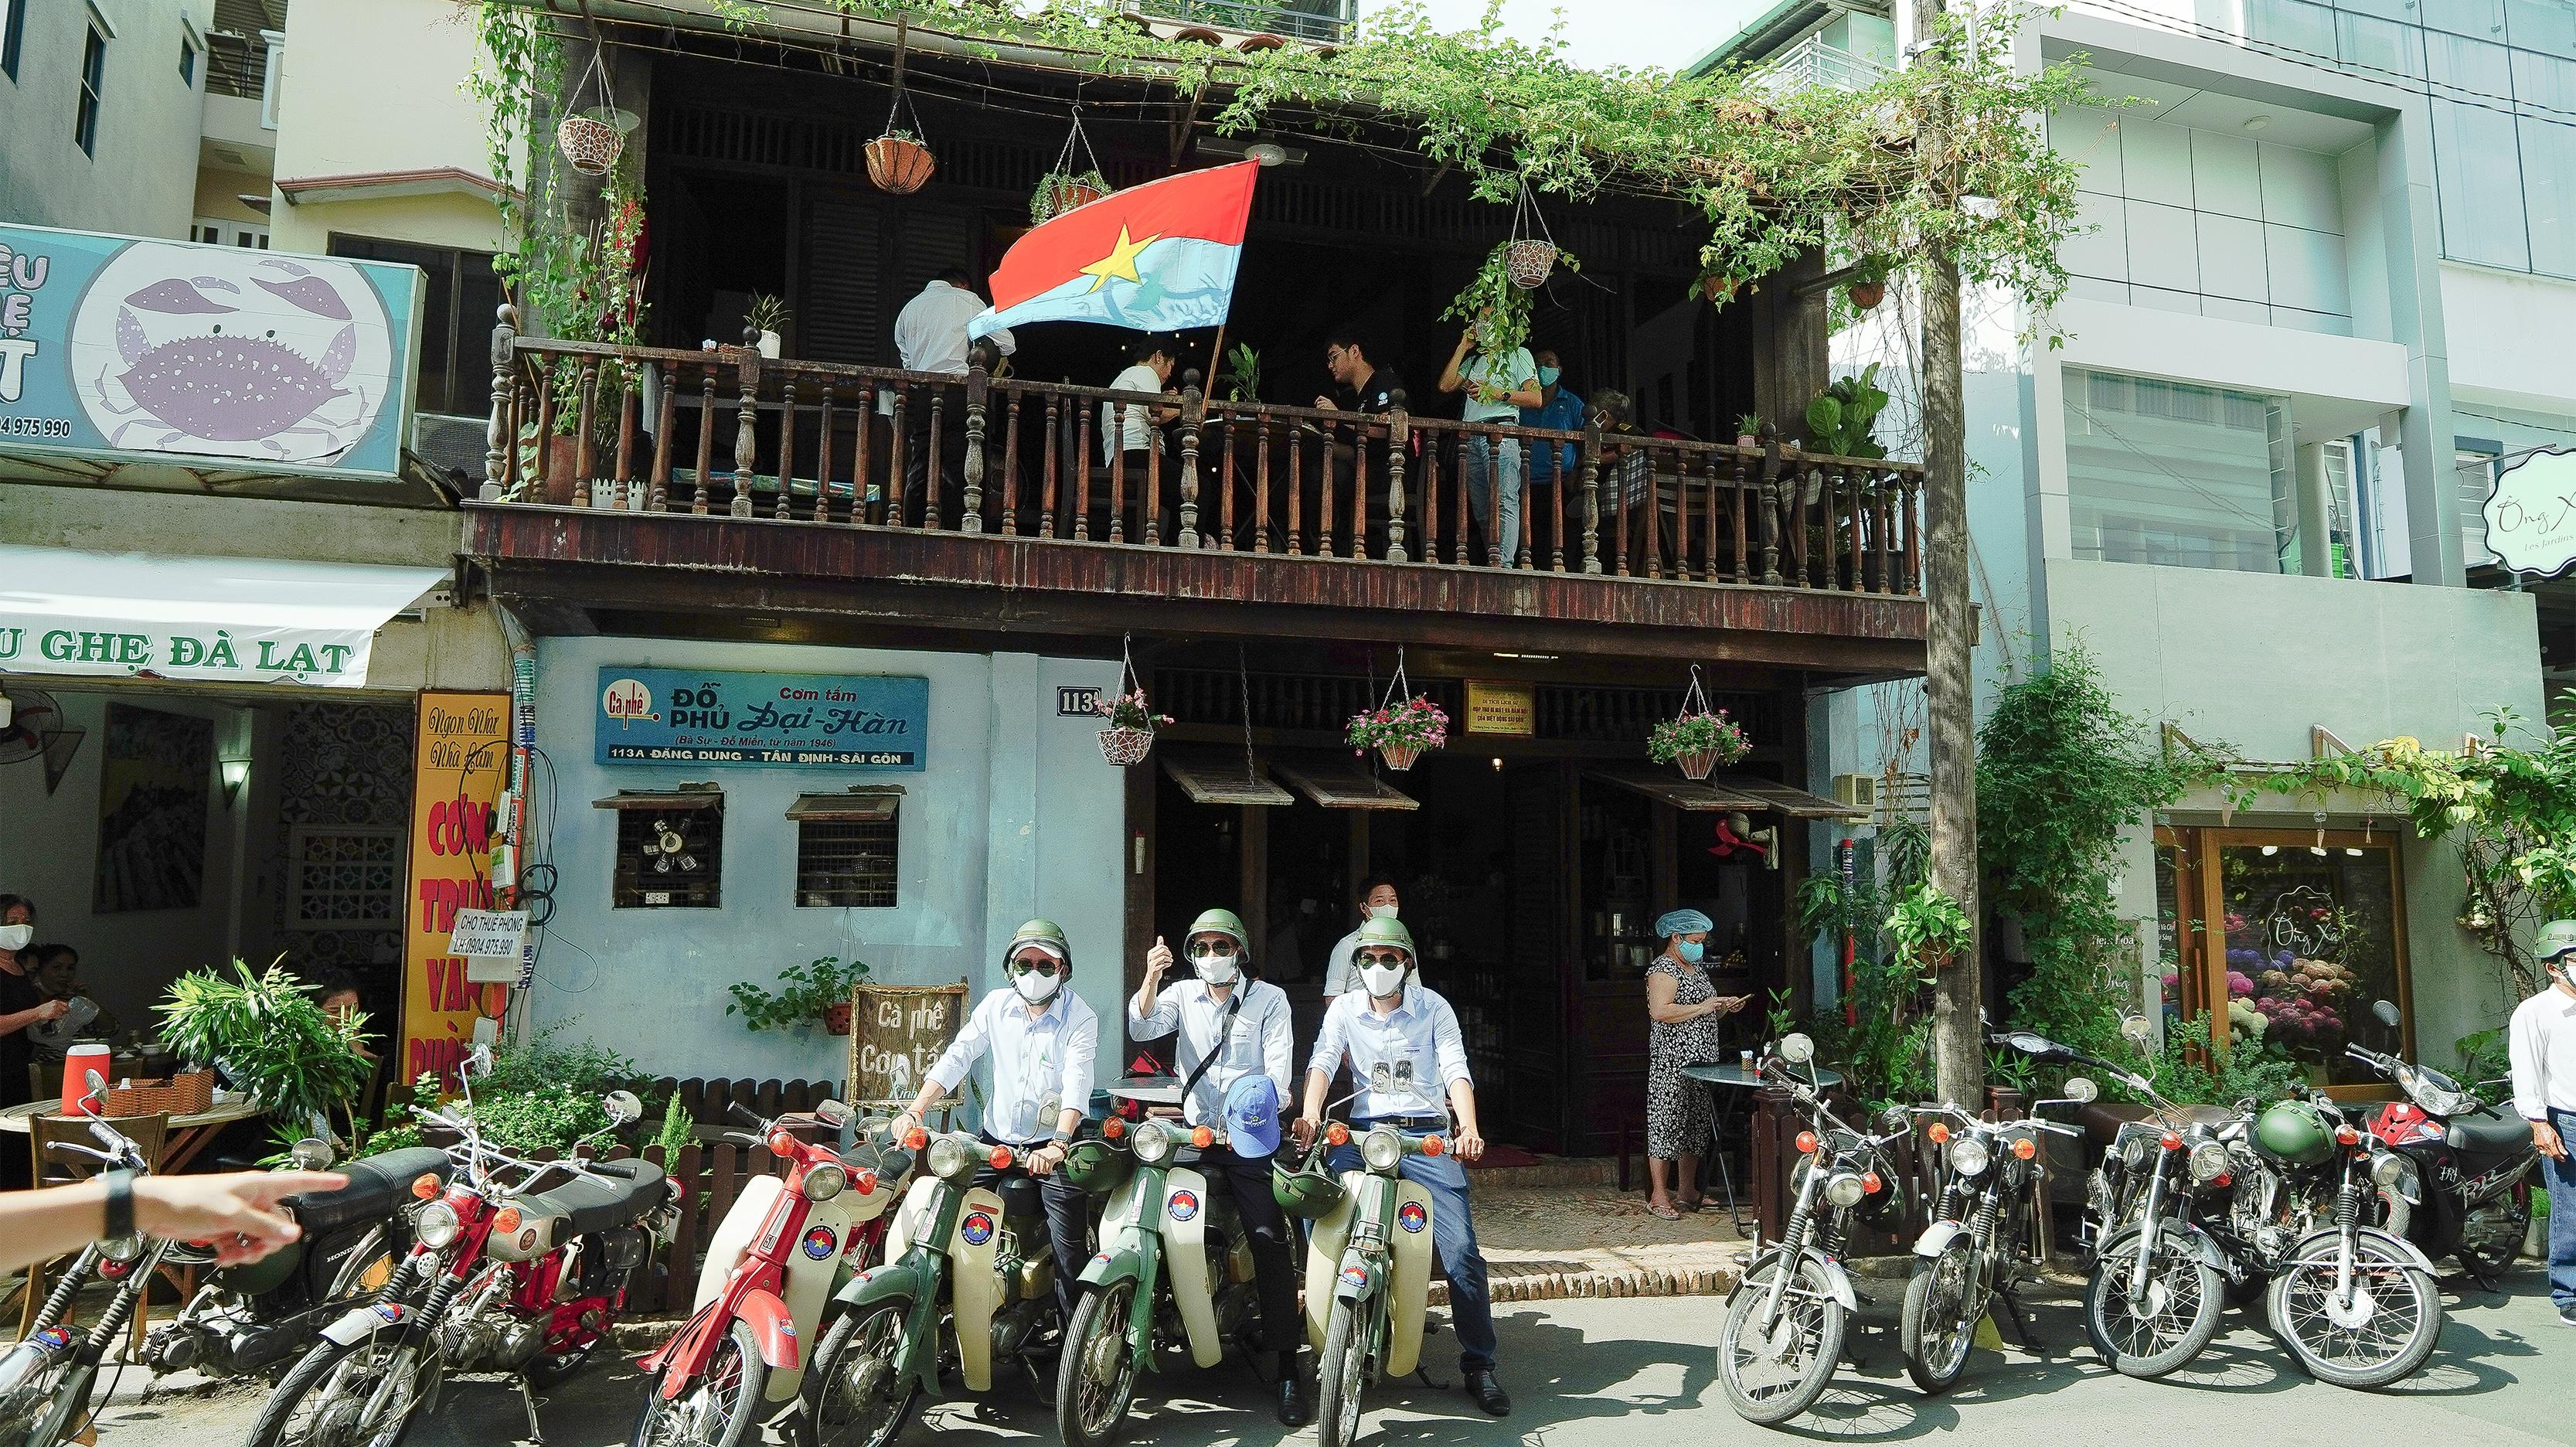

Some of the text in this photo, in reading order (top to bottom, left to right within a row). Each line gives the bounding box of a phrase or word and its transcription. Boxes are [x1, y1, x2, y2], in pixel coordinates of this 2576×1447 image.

[0, 415, 71, 438] 4 975 990
[2497, 495, 2549, 534] Ông
[2542, 534, 2574, 550] Jardins
[40, 629, 152, 672] GHẸ
[168, 629, 242, 669] ĐÀ
[256, 640, 355, 681] LẠT
[608, 683, 644, 729] Cà phê
[670, 682, 722, 709] ĐỖ
[779, 685, 857, 702] Cơm tấm
[429, 706, 464, 739] Ngon
[669, 704, 730, 730] PHỦ
[737, 701, 909, 734] Đại-Hàn
[430, 741, 463, 768] Nhà
[611, 748, 645, 758] 113A
[650, 747, 693, 760] ĐẶNG
[698, 751, 742, 761] DUNG
[761, 750, 791, 762] TÂN
[870, 751, 901, 764] GÒN
[675, 736, 693, 745] (Bà
[770, 738, 781, 747] từ
[784, 737, 806, 747] năm
[809, 739, 836, 748] 1946)
[428, 792, 492, 856] CƠM
[461, 914, 478, 931] CHO
[478, 913, 499, 931] THUÊ
[2275, 911, 2311, 955] Ông
[878, 998, 944, 1040] Cà phê
